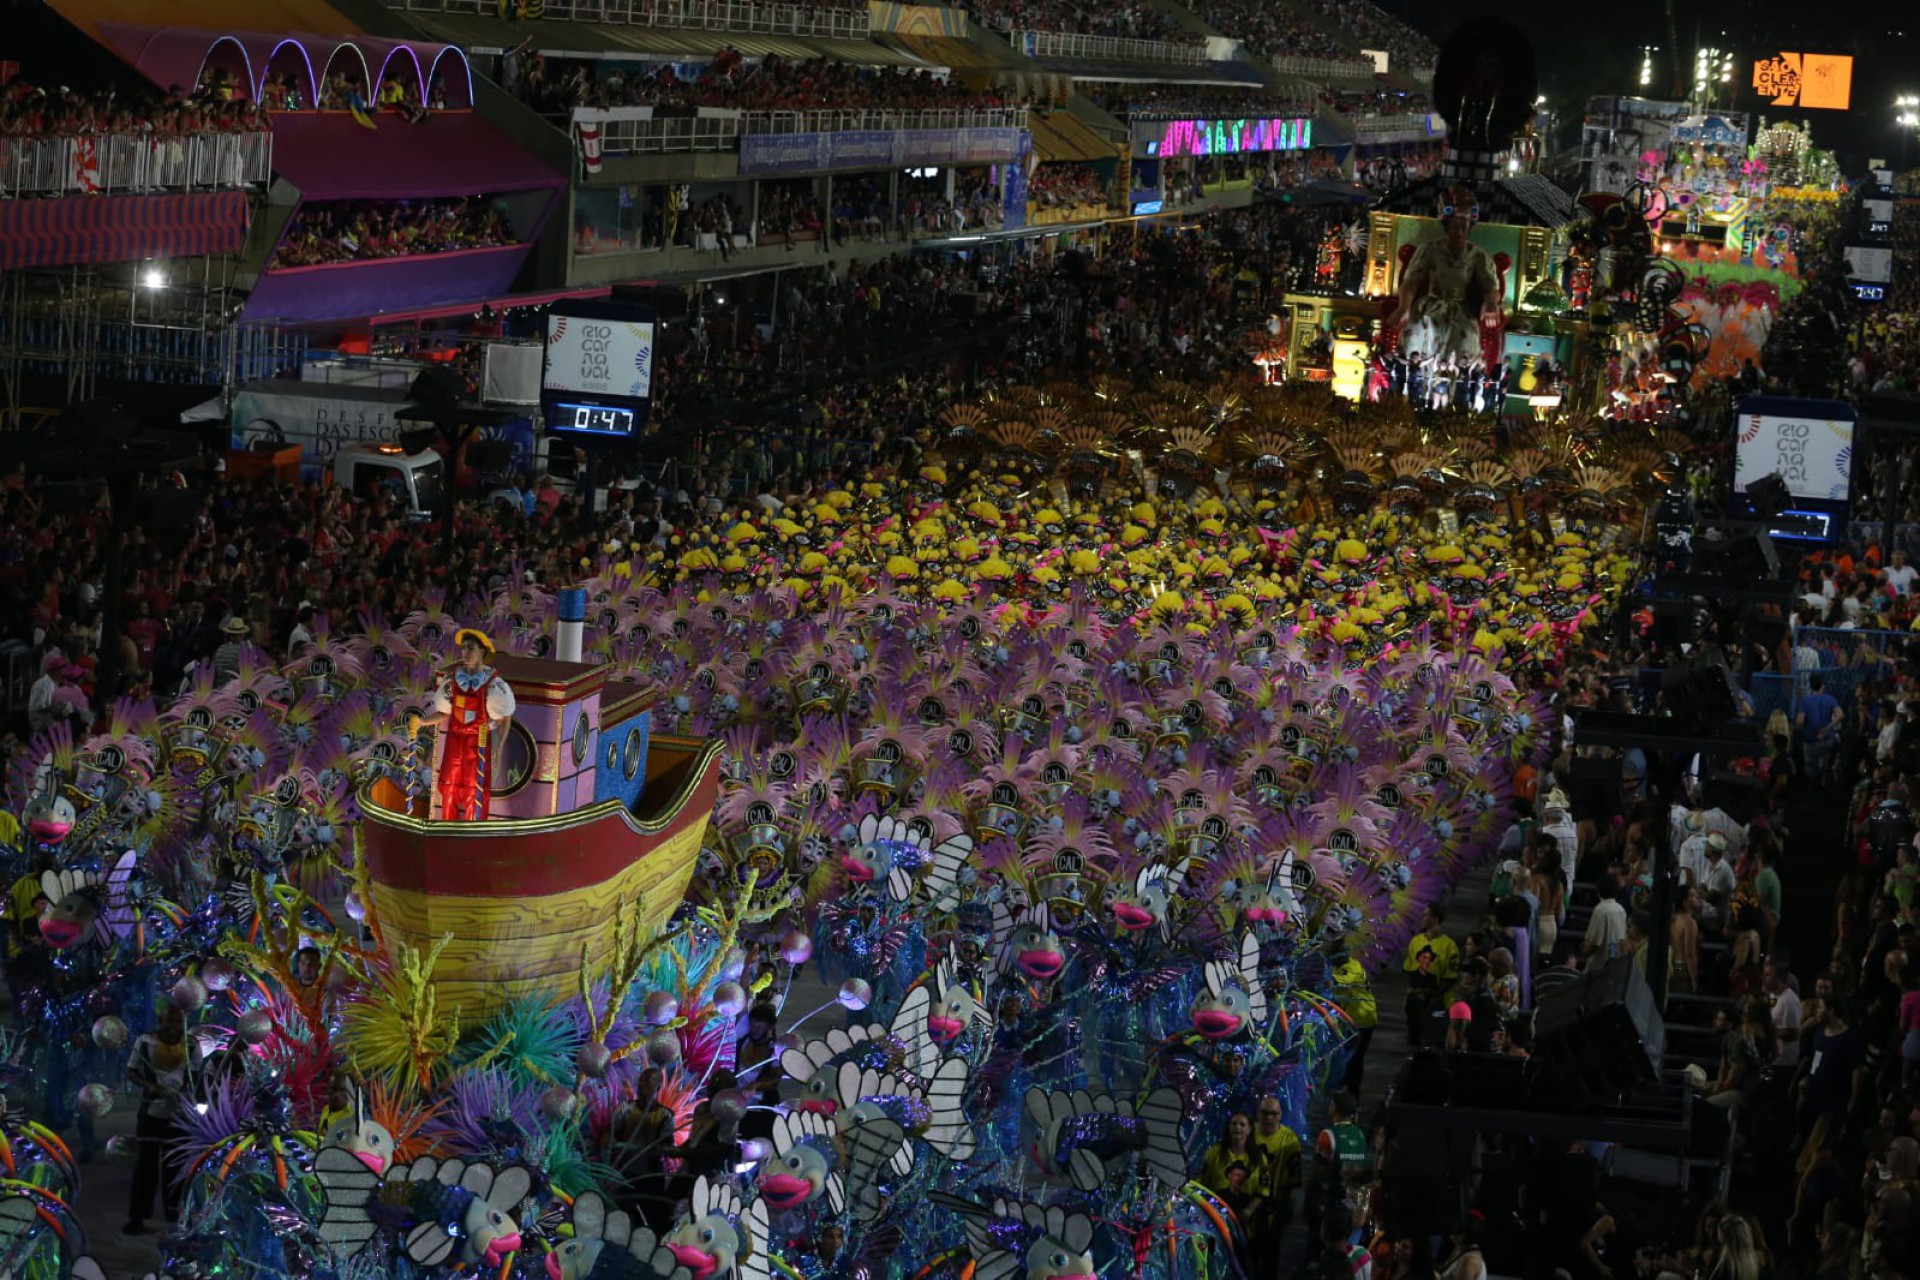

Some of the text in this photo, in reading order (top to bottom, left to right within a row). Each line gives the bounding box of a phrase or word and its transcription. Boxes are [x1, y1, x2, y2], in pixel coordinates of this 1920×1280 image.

[581, 325, 612, 339] RIO
[574, 407, 634, 432] 0:47
[316, 422, 351, 441] DAS
[1777, 424, 1810, 438] RIO
[100, 751, 116, 767] CAL
[750, 808, 769, 824] CAL
[1059, 856, 1078, 871] CAL
